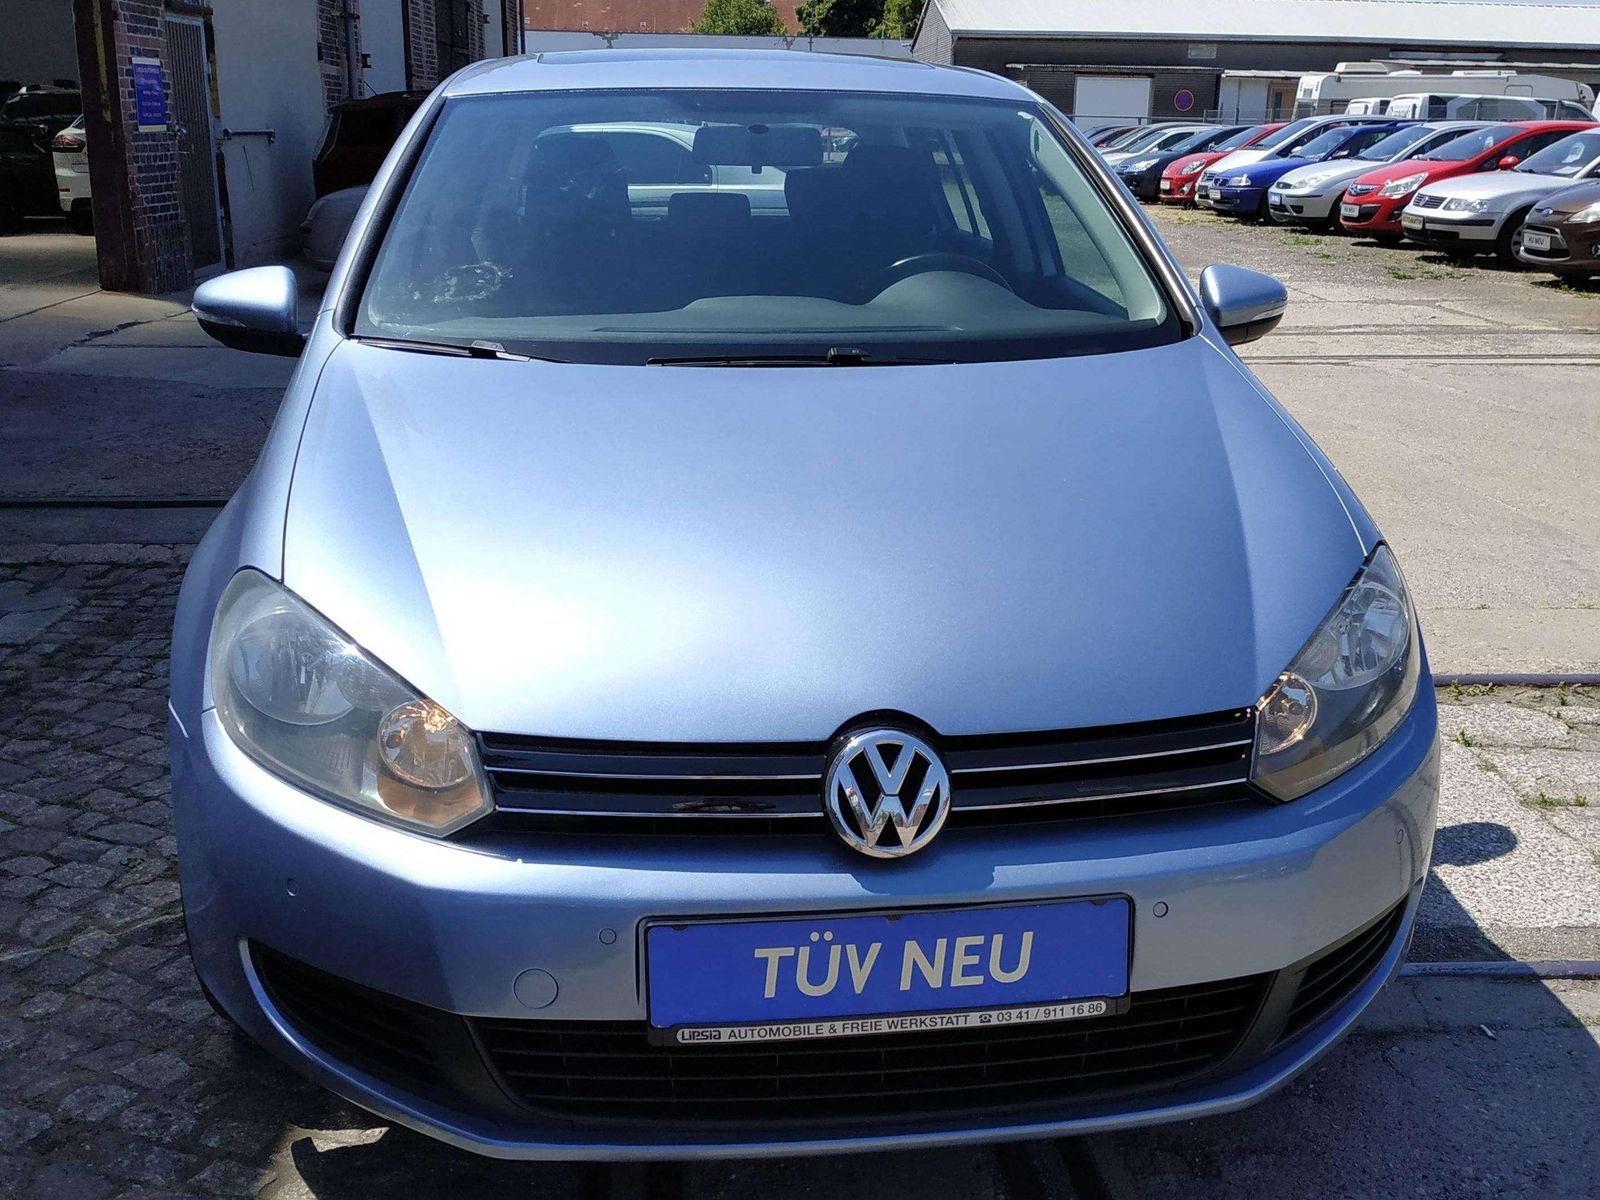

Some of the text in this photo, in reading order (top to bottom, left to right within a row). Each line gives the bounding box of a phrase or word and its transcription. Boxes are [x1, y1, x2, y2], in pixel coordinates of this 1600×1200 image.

[834, 738, 944, 852] VW
[754, 930, 1034, 999] TÜV NEU
[728, 1024, 824, 1040] AUTOMOBILE
[828, 1023, 838, 1034] &
[842, 1020, 883, 1033] FREIE
[886, 1014, 970, 1029] WERKSTATT
[997, 1011, 1012, 1022] 03
[1015, 1009, 1029, 1021] 41
[1043, 1007, 1065, 1018] 911
[1071, 1004, 1084, 1015] 16
[1087, 1002, 1103, 1013] 86
